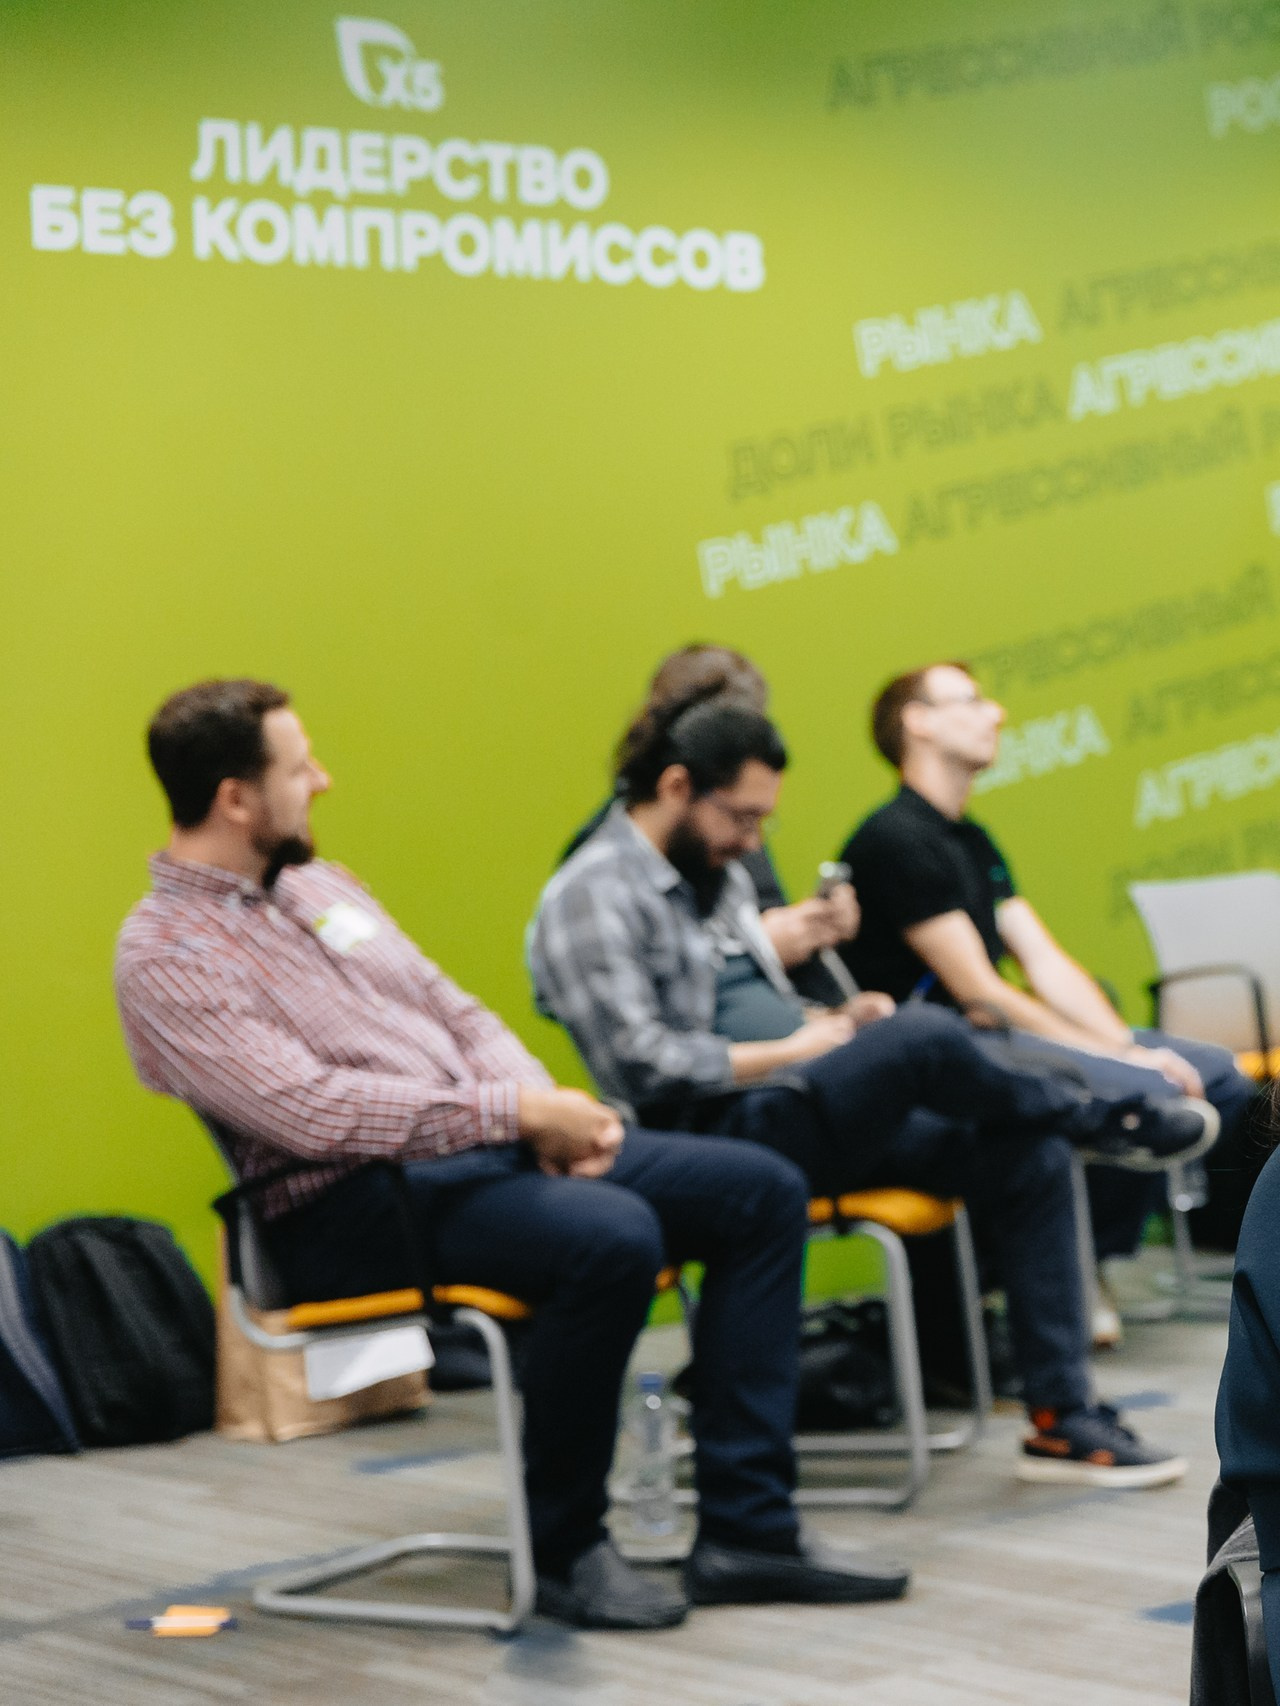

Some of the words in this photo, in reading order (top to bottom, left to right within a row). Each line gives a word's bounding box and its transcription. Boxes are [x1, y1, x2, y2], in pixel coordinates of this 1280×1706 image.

[377, 56, 446, 113] X5
[191, 116, 610, 210] ЛИДЕРСТВО
[29, 184, 175, 258] БЕЗ
[191, 195, 765, 292] КОМПРОМИССОВ
[853, 288, 1044, 379] РЫНКА
[724, 410, 878, 508] ДОЛИ
[882, 374, 1067, 464] РЫНКА
[696, 499, 901, 600] РЫНКА
[903, 398, 1250, 552] АГРЕССИВНЫЙ
